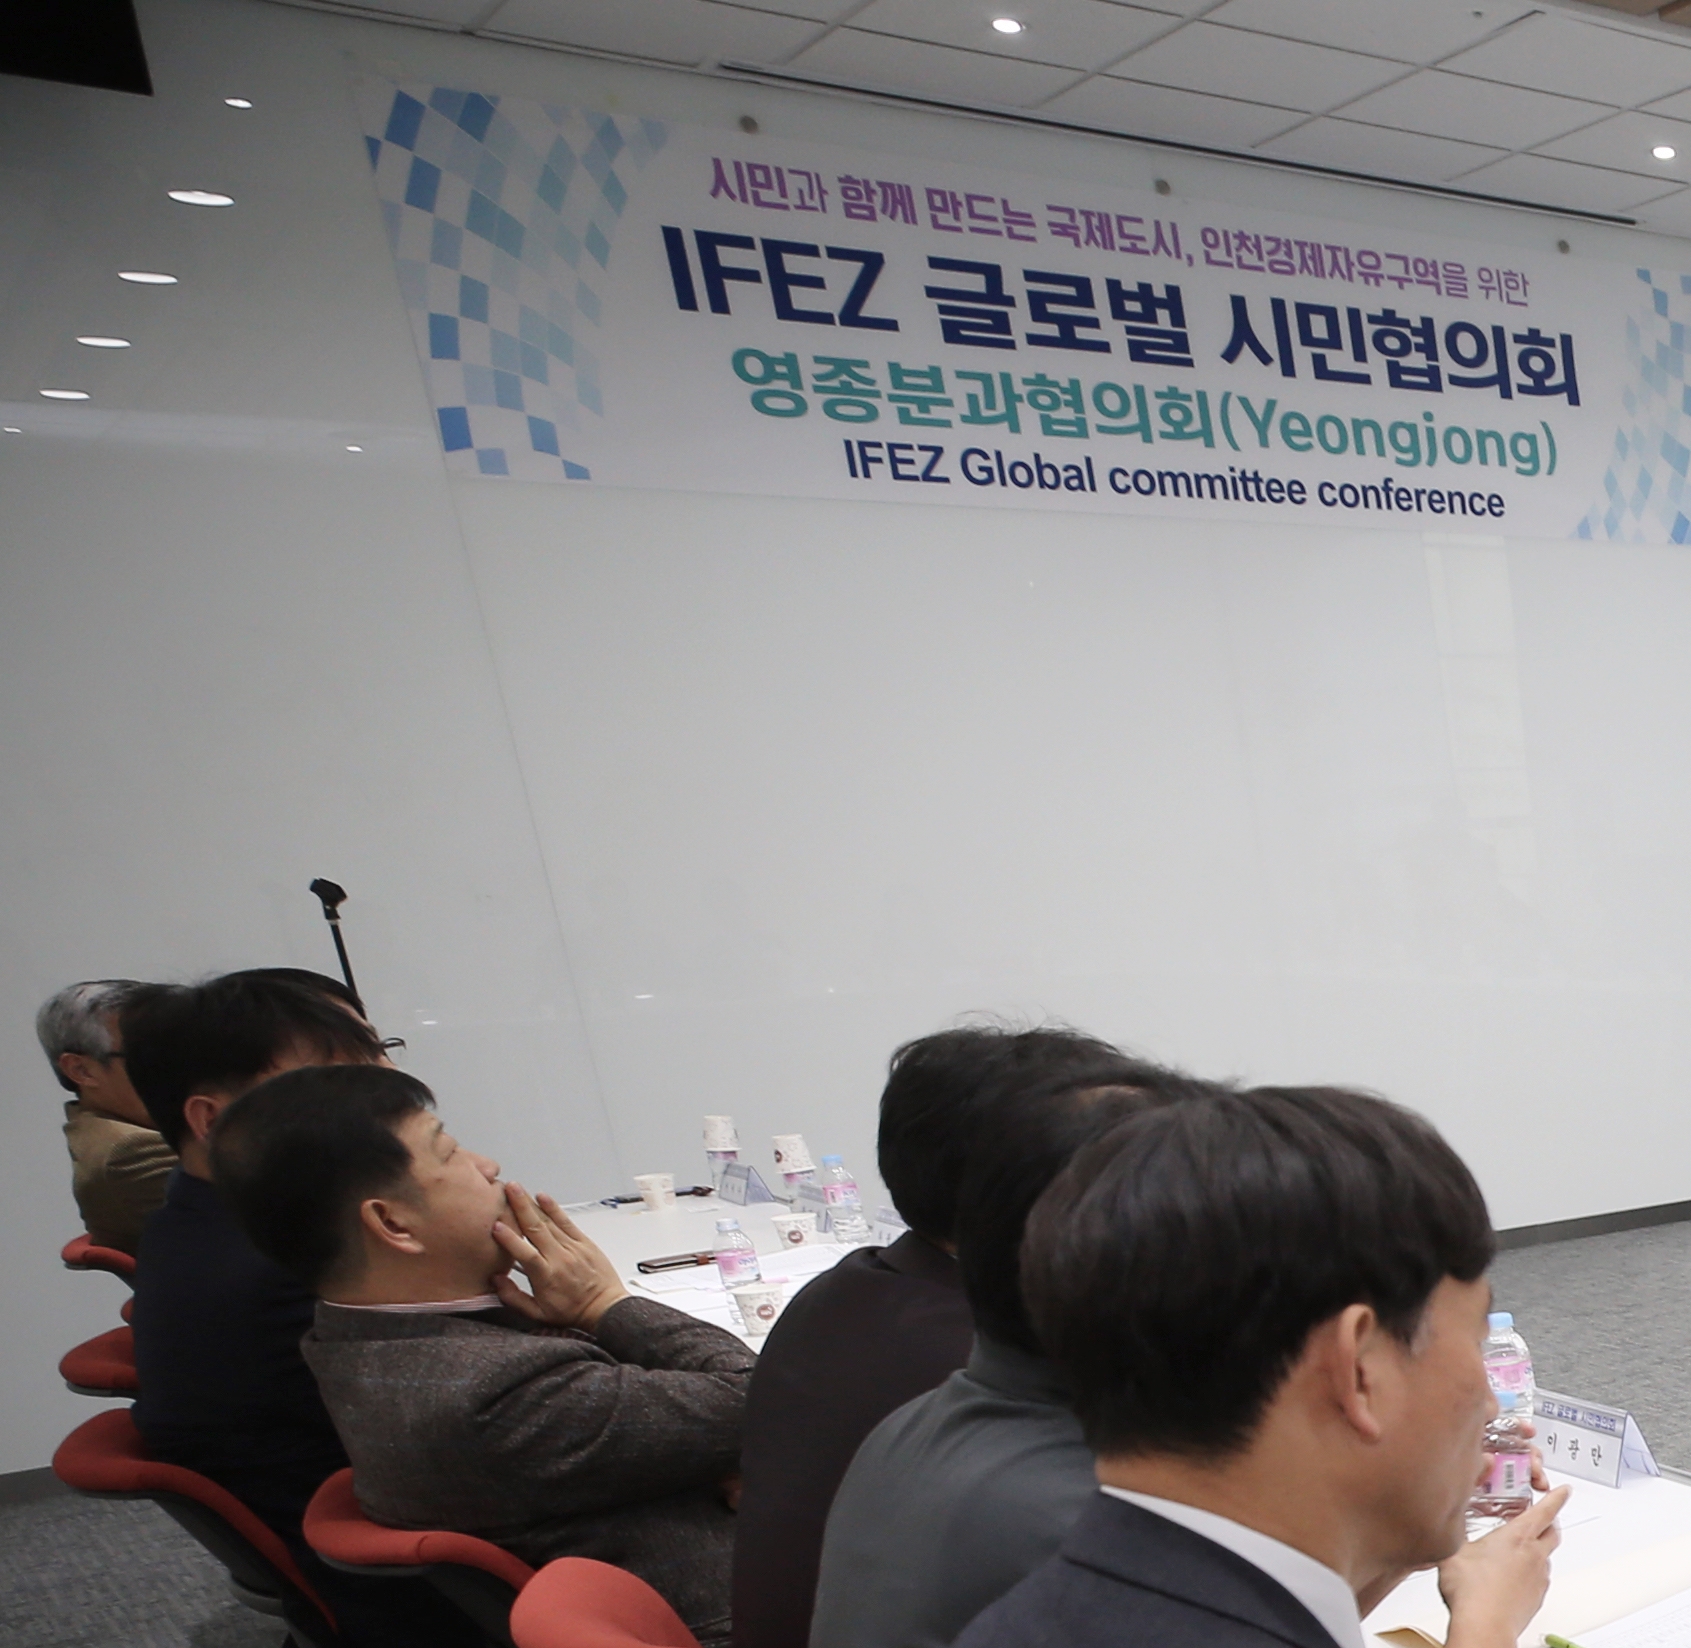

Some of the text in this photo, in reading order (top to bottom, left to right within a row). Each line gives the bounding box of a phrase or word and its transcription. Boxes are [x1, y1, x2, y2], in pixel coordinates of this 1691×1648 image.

[709, 156, 1531, 308] 시민과 함께 만드는 국제도시, 인천경제자유구역을 위한
[660, 224, 1582, 407] IFEZ 글로벌 시민협의회
[842, 438, 1506, 519] IFEZ Global committee conference
